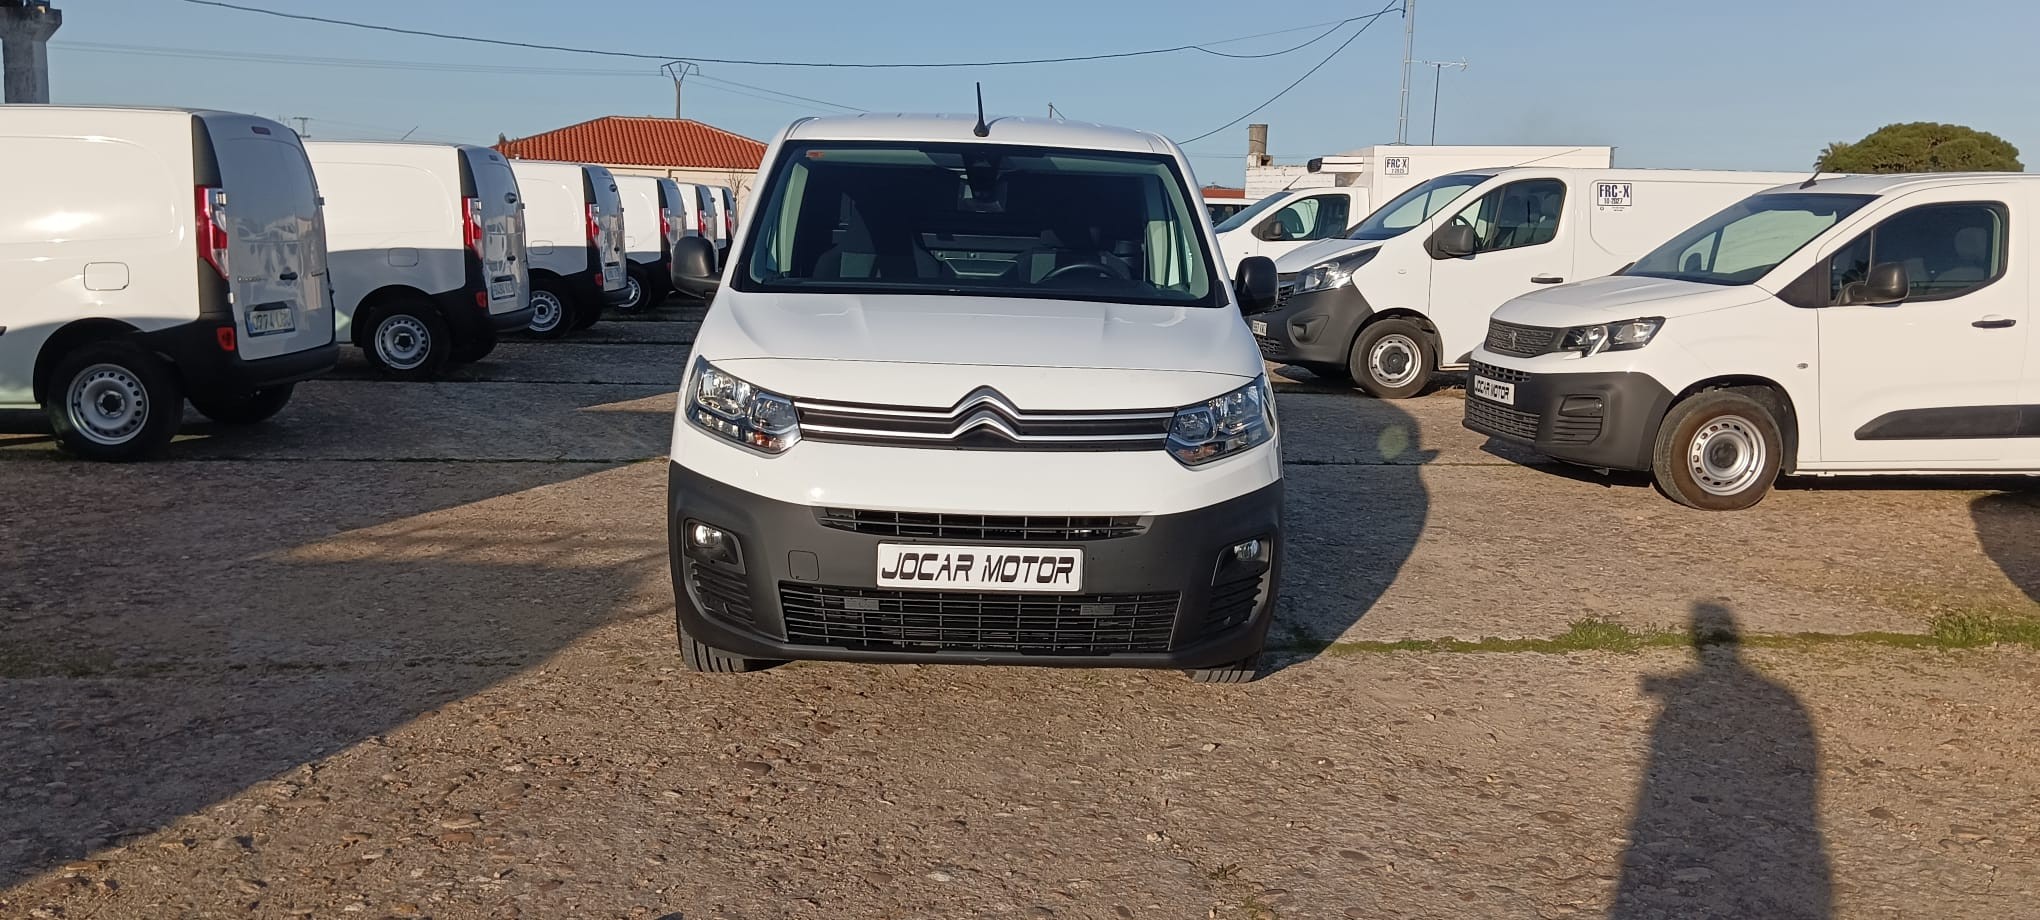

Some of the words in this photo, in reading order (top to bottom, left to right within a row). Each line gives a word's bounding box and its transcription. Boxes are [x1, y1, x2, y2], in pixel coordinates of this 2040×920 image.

[1599, 184, 1630, 198] FRC-X
[881, 552, 975, 582] JOCAR
[981, 554, 1075, 585] MOTOR
